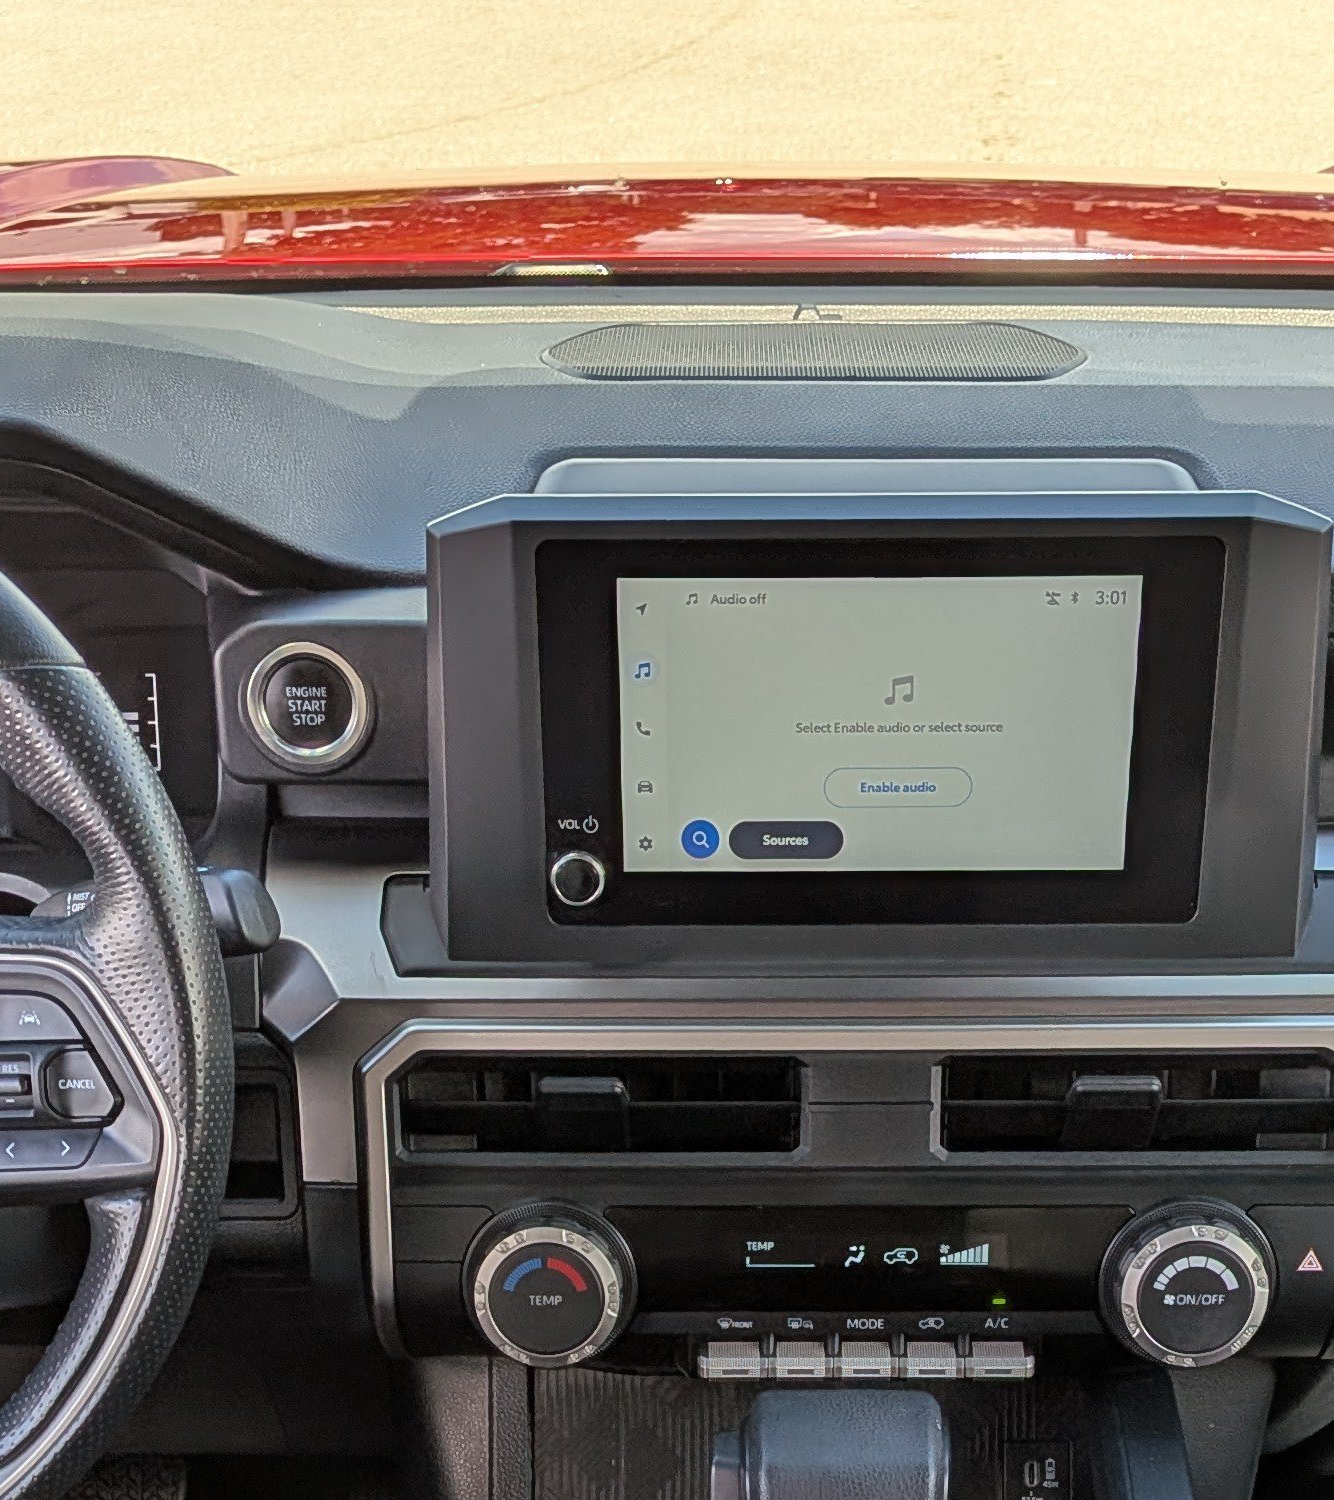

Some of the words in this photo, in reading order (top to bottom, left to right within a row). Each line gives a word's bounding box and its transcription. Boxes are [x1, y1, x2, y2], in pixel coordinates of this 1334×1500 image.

[710, 592, 747, 605] Audio
[748, 592, 768, 605] off
[1095, 590, 1127, 605] 3:01
[285, 686, 327, 698] ENGINE
[287, 699, 327, 712] START
[292, 713, 326, 726] STOP
[795, 722, 832, 734] Select
[833, 721, 875, 734] Enable
[876, 721, 911, 733] audio
[912, 724, 927, 733] or
[927, 721, 963, 733] select
[964, 723, 1004, 733] source
[859, 781, 900, 793] Enable
[902, 781, 937, 793] audio
[557, 818, 581, 830] VOL
[762, 834, 809, 847] Sources
[58, 1078, 96, 1090] CANCEL
[745, 1241, 775, 1252] TEMP
[529, 1294, 563, 1306] TEMP
[1176, 1293, 1226, 1306] ON/OFF
[846, 1318, 885, 1330] MODE
[984, 1317, 1010, 1330] A/C
